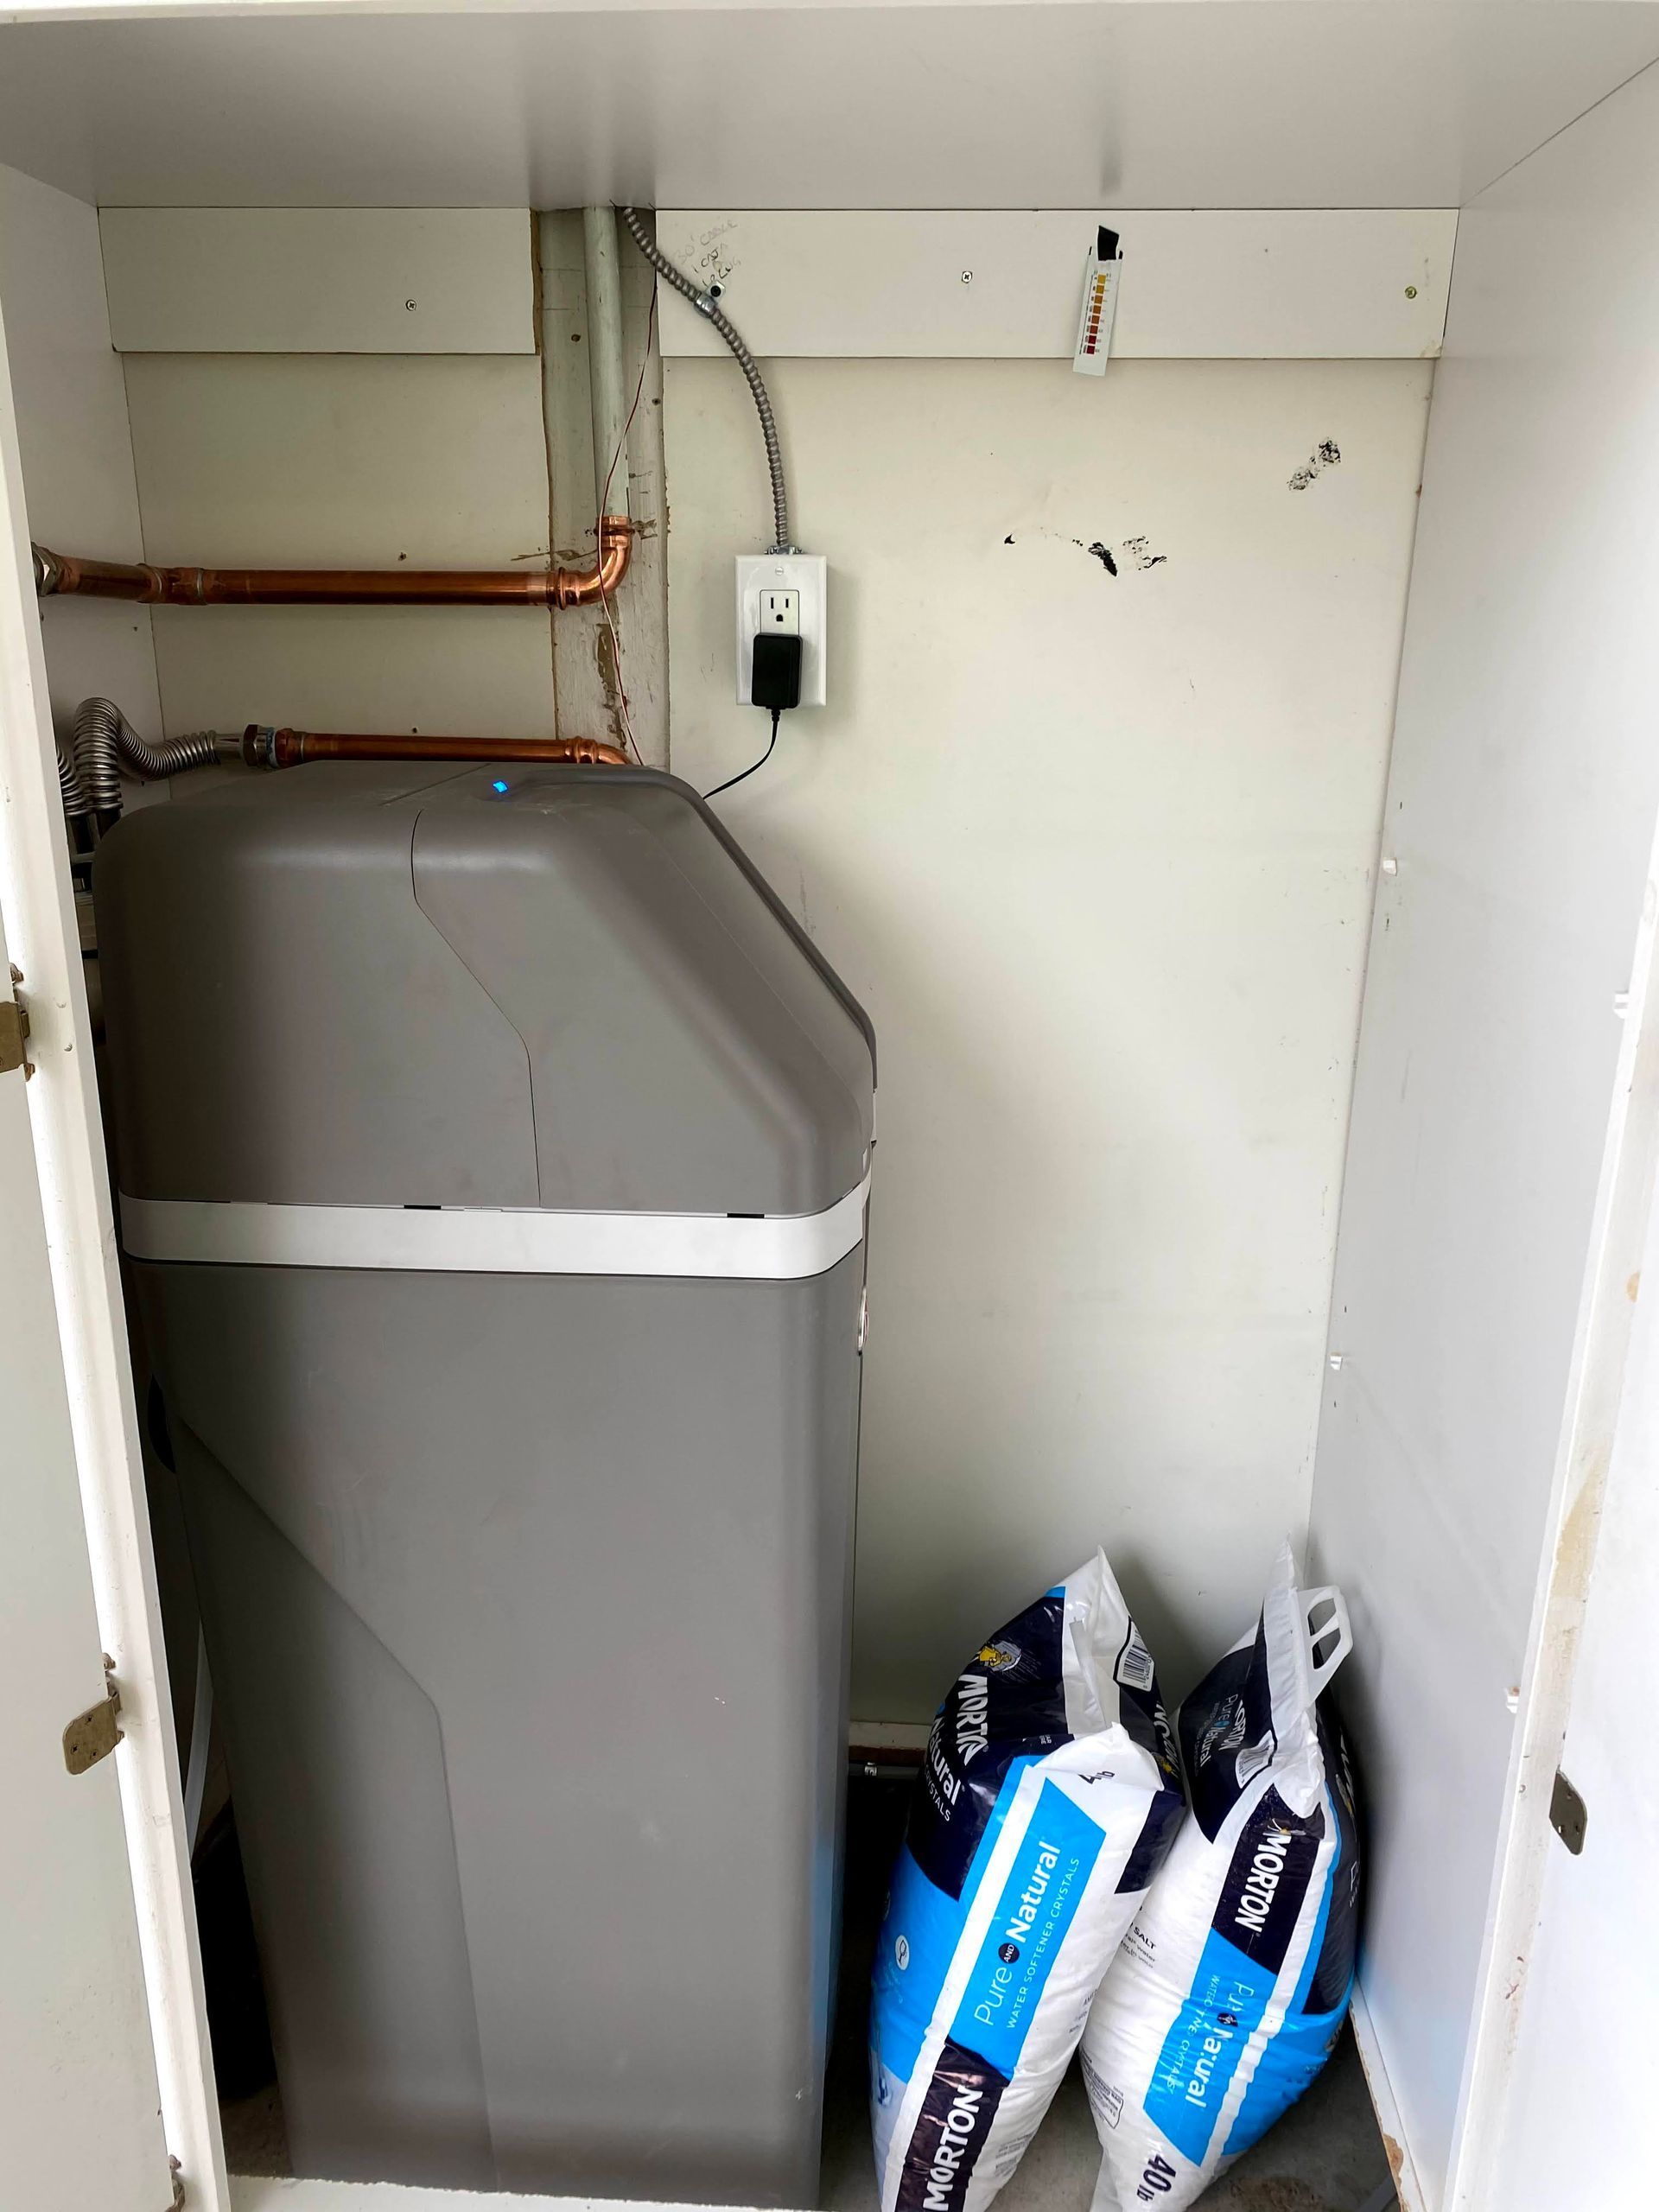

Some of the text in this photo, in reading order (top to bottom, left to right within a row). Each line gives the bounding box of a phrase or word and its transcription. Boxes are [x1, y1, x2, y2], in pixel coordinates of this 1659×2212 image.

[1200, 1726, 1226, 1767] Natural
[974, 1841, 1060, 2025] Pure AND Natural
[1235, 1832, 1292, 1933] MORTON
[1007, 1858, 1079, 2029] WATER SOFTENER CRYSTALS
[1134, 1926, 1156, 1949] SALT
[923, 2086, 983, 2210] MORTON
[1136, 2153, 1177, 2203] 40 lb
